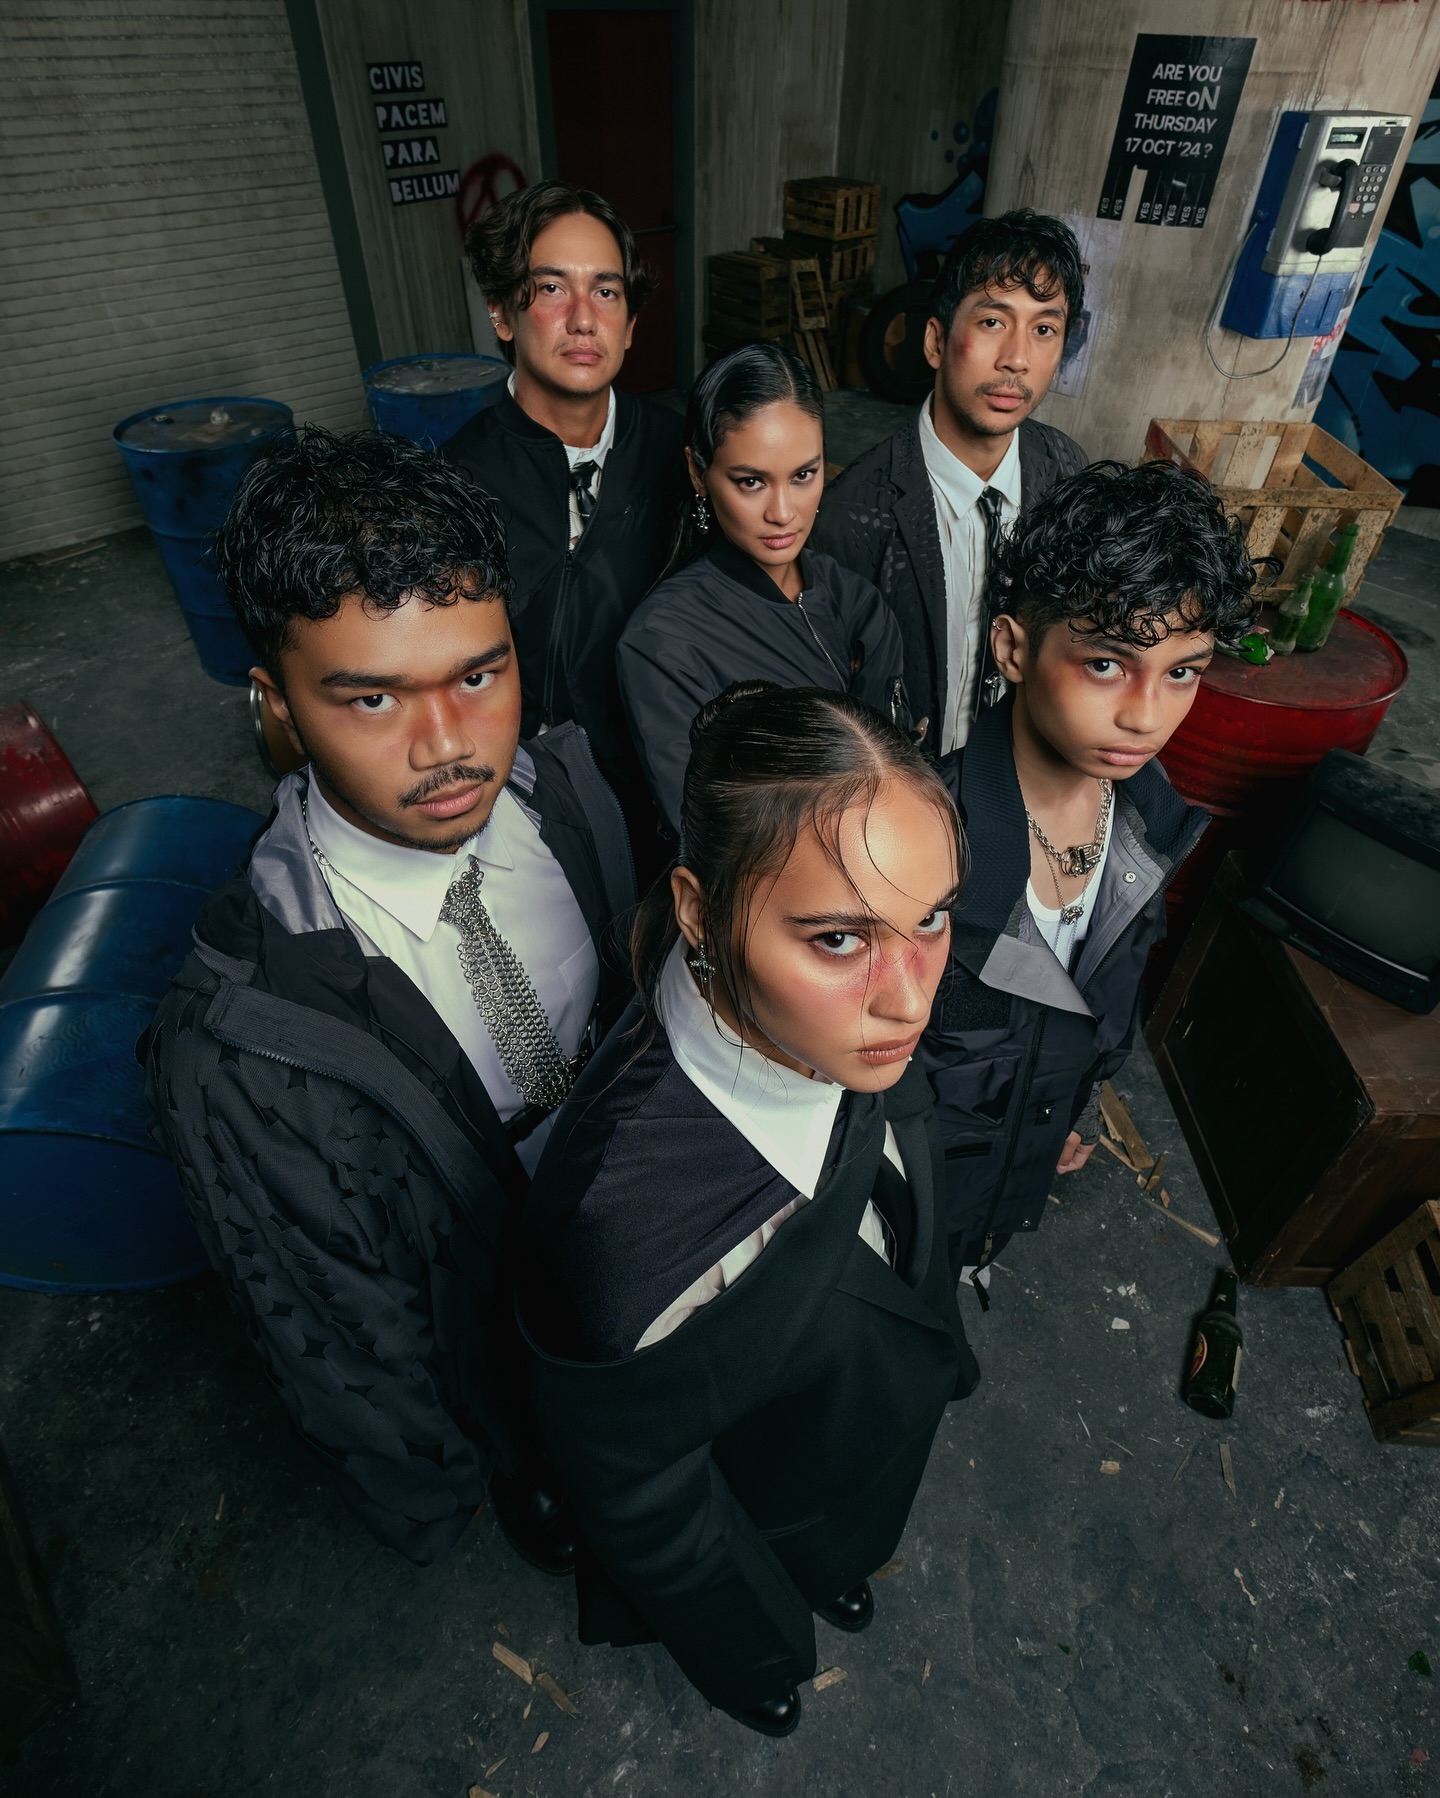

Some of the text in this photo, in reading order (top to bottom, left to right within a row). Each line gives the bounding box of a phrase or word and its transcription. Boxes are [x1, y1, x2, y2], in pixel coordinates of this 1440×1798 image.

[369, 65, 424, 91] CIVIS
[1152, 63, 1223, 82] ARE YOU
[1146, 88, 1186, 107] FREE
[375, 102, 446, 129] PACEM
[1134, 112, 1218, 134] THURSDAY
[383, 139, 439, 166] PARA
[1125, 137, 1142, 153] 17
[1141, 138, 1176, 156] OCT
[390, 172, 460, 203] BELLUM
[1100, 197, 1110, 214] YES
[1113, 199, 1123, 217] YES
[1139, 202, 1151, 220] YES
[1152, 203, 1163, 222] YES
[1166, 204, 1177, 223] YES
[1180, 206, 1191, 225] YES
[1194, 207, 1206, 225] YES
